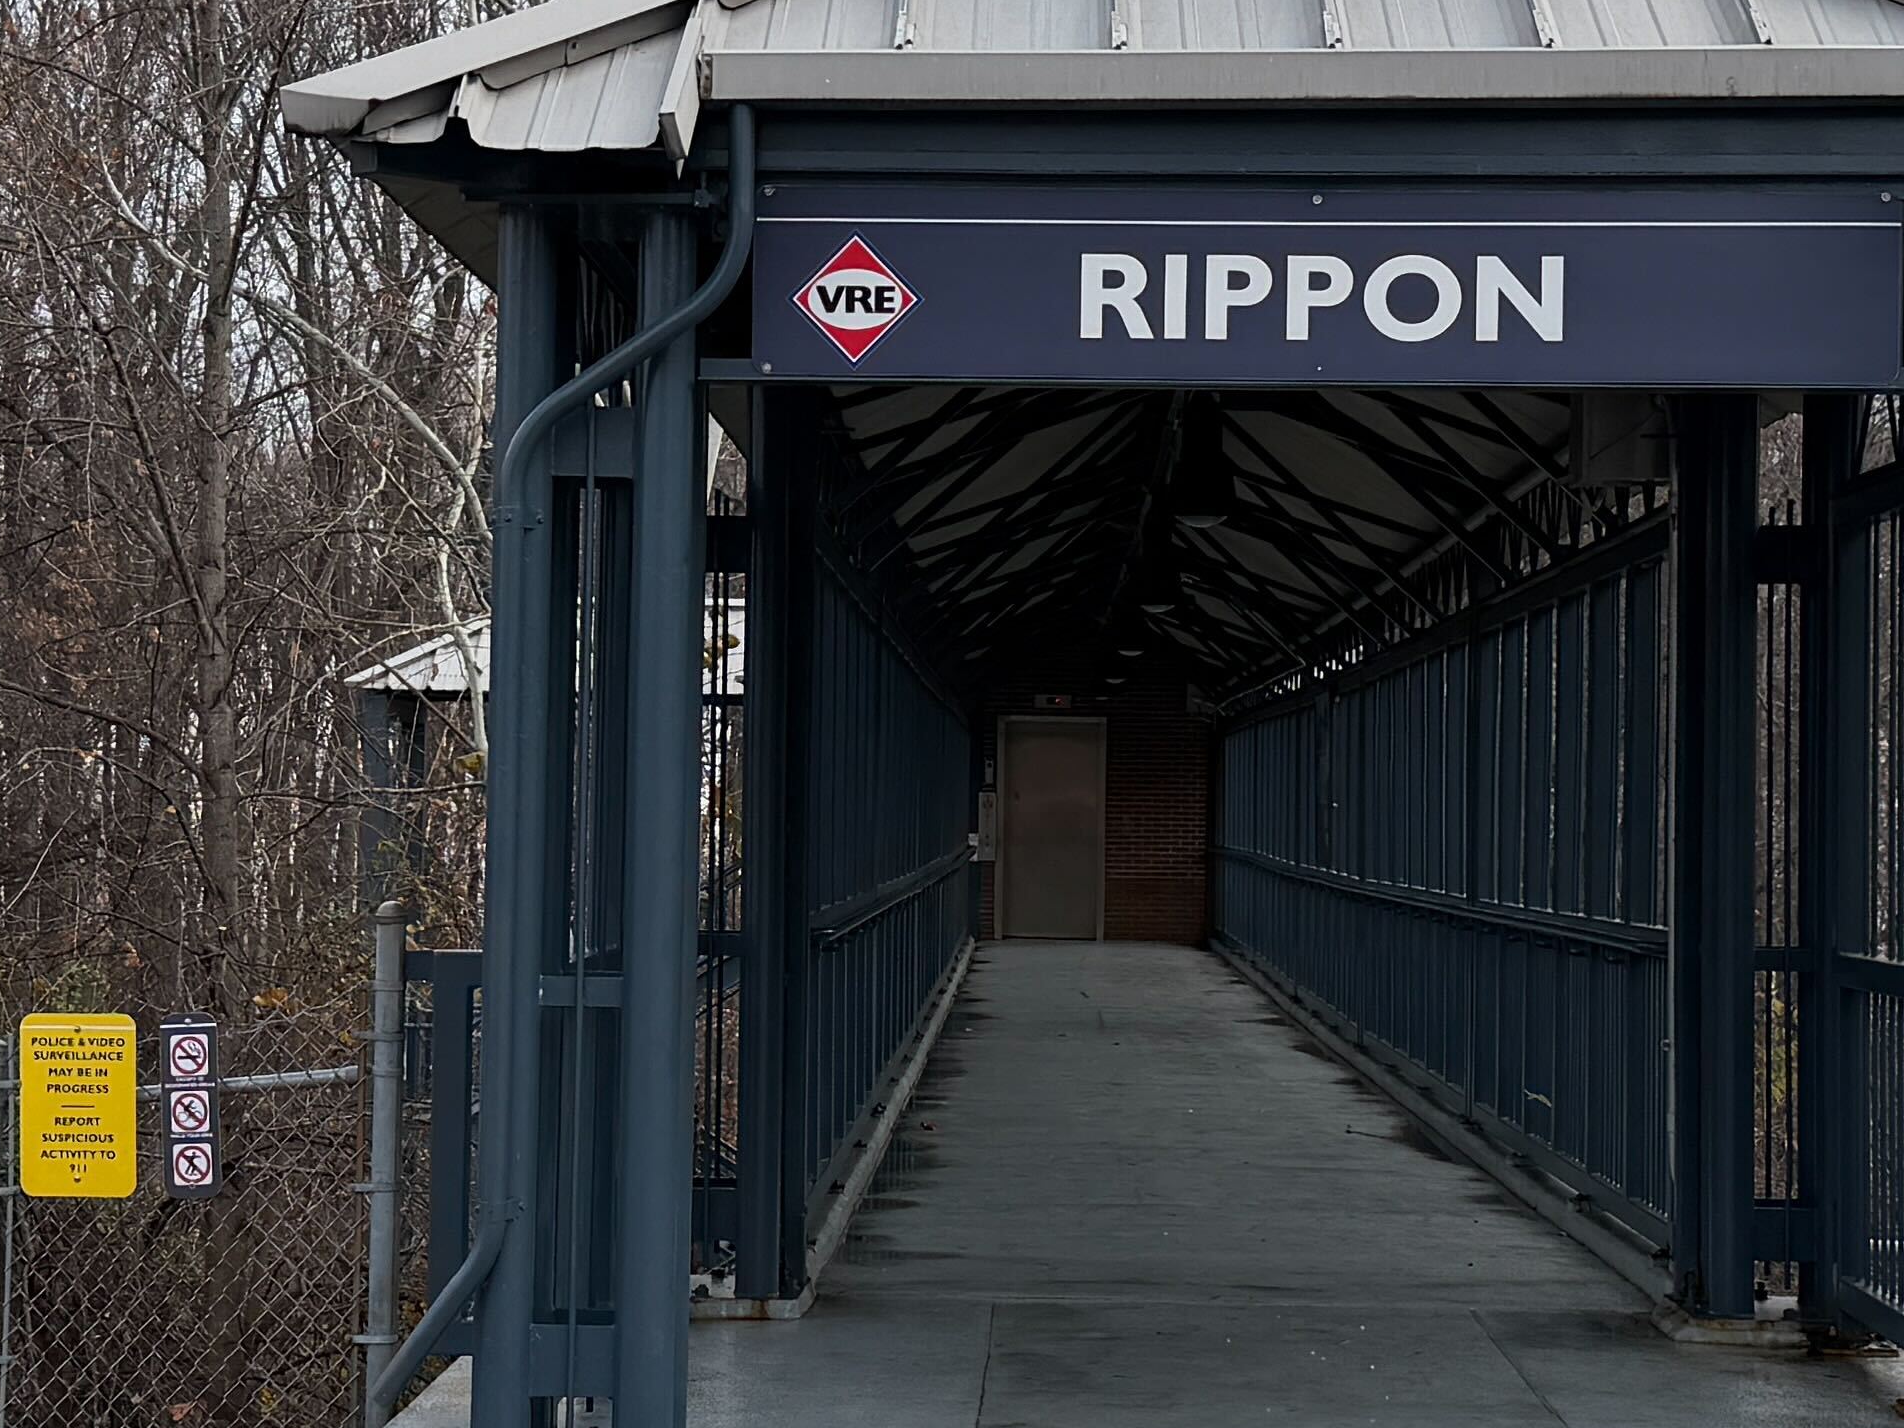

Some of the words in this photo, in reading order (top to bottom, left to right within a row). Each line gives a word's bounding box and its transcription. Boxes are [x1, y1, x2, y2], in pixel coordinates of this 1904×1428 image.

[815, 285, 897, 314] VRE
[1079, 252, 1565, 342] RIPPON
[31, 1036, 75, 1047] POLICE
[77, 1036, 86, 1047] &
[87, 1037, 126, 1048] VIDEO
[33, 1050, 124, 1061] SURVEILLANCE
[48, 1067, 74, 1077] MAY
[76, 1067, 92, 1077] BE
[94, 1067, 108, 1077] IN
[46, 1083, 109, 1094] PROGRESS
[54, 1116, 102, 1126] REPORT
[41, 1132, 114, 1143] SUSPICIOUS
[40, 1149, 97, 1160] ACTIVITY
[99, 1150, 116, 1160] TO
[69, 1163, 87, 1173] 911
